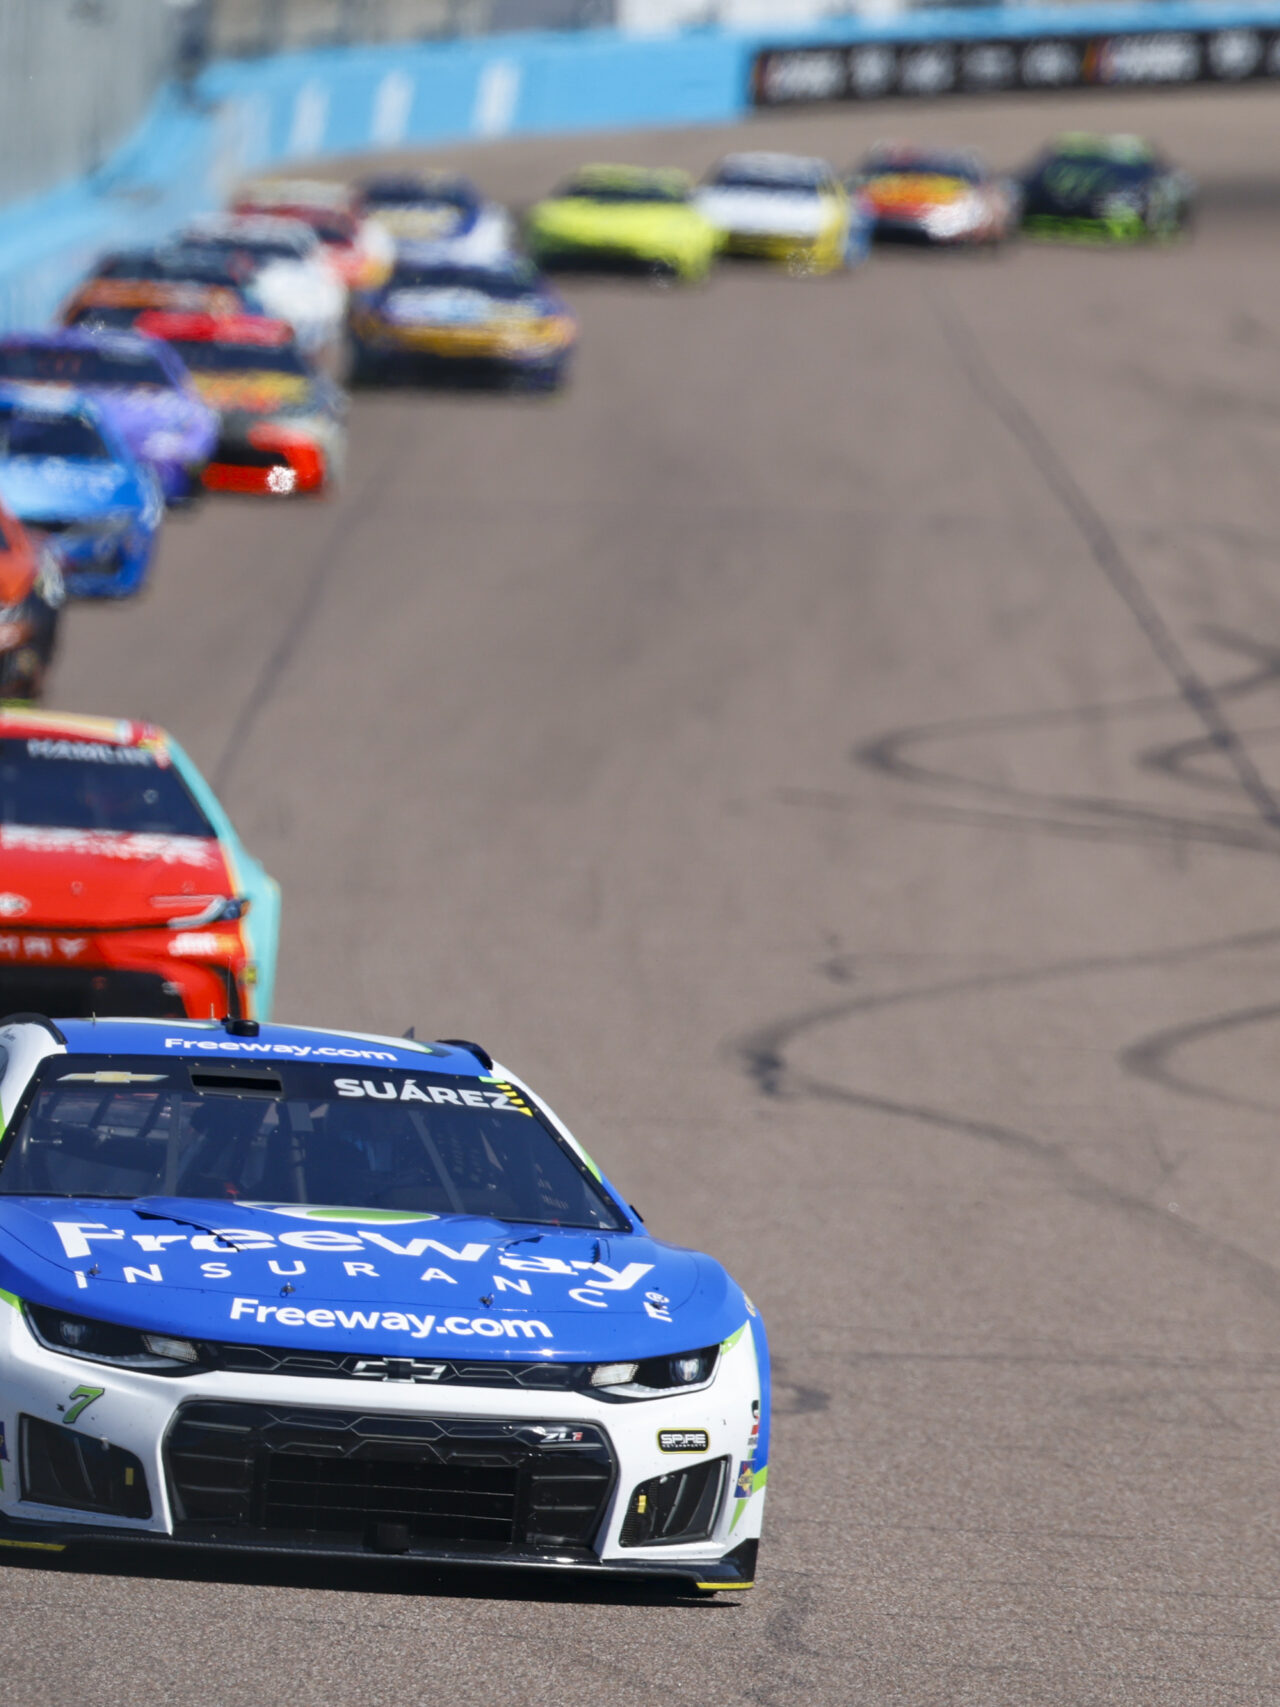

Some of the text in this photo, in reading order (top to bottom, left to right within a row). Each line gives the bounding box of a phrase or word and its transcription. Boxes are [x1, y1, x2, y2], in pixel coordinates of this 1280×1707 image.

[164, 1037, 399, 1062] Freeway.com
[333, 1078, 519, 1112] SUÁREZ
[52, 1220, 655, 1291] Freeway
[73, 1260, 673, 1323] INSURANCE
[229, 1296, 554, 1339] Freeway.com
[62, 1384, 106, 1424] 7
